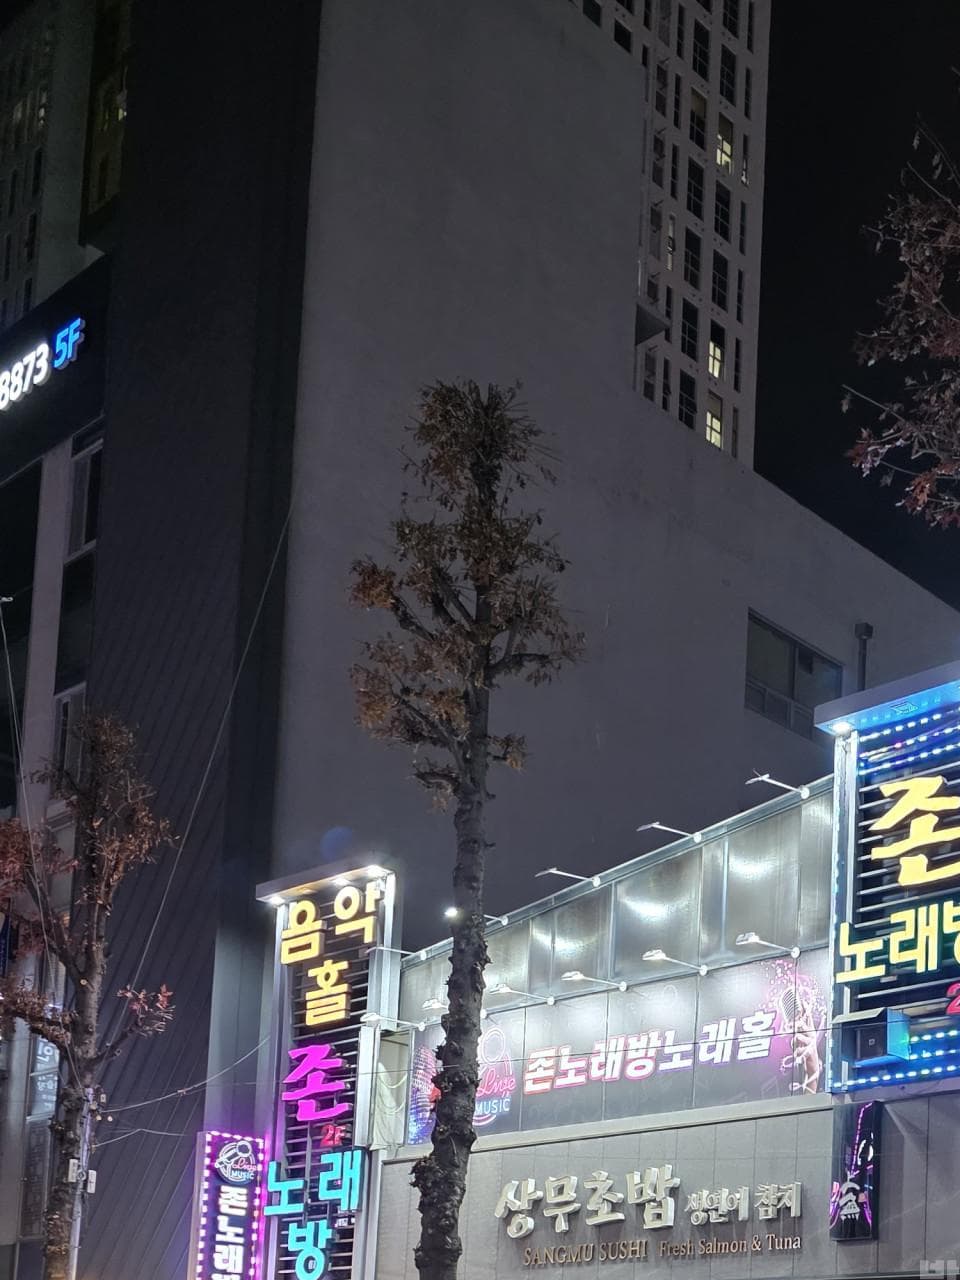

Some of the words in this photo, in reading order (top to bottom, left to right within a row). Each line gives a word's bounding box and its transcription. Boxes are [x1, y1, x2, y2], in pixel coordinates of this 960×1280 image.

[54, 318, 85, 369] 5F
[281, 885, 378, 965] 음악
[305, 959, 351, 1026] 홀
[282, 1044, 351, 1122] 존
[523, 1009, 777, 1096] 존노래방노래홀
[320, 1123, 346, 1147] 2F
[474, 1098, 511, 1114] MUSIC
[264, 1149, 363, 1216] 노래
[494, 1164, 681, 1239] 상무초밥
[684, 1186, 750, 1226] 생연어
[522, 1244, 594, 1266] SANGMU
[599, 1239, 648, 1262] SUSHI
[659, 1238, 695, 1257] Fresh
[699, 1237, 747, 1255] Salmon
[751, 1235, 762, 1251] &
[766, 1233, 802, 1251] Tuna
